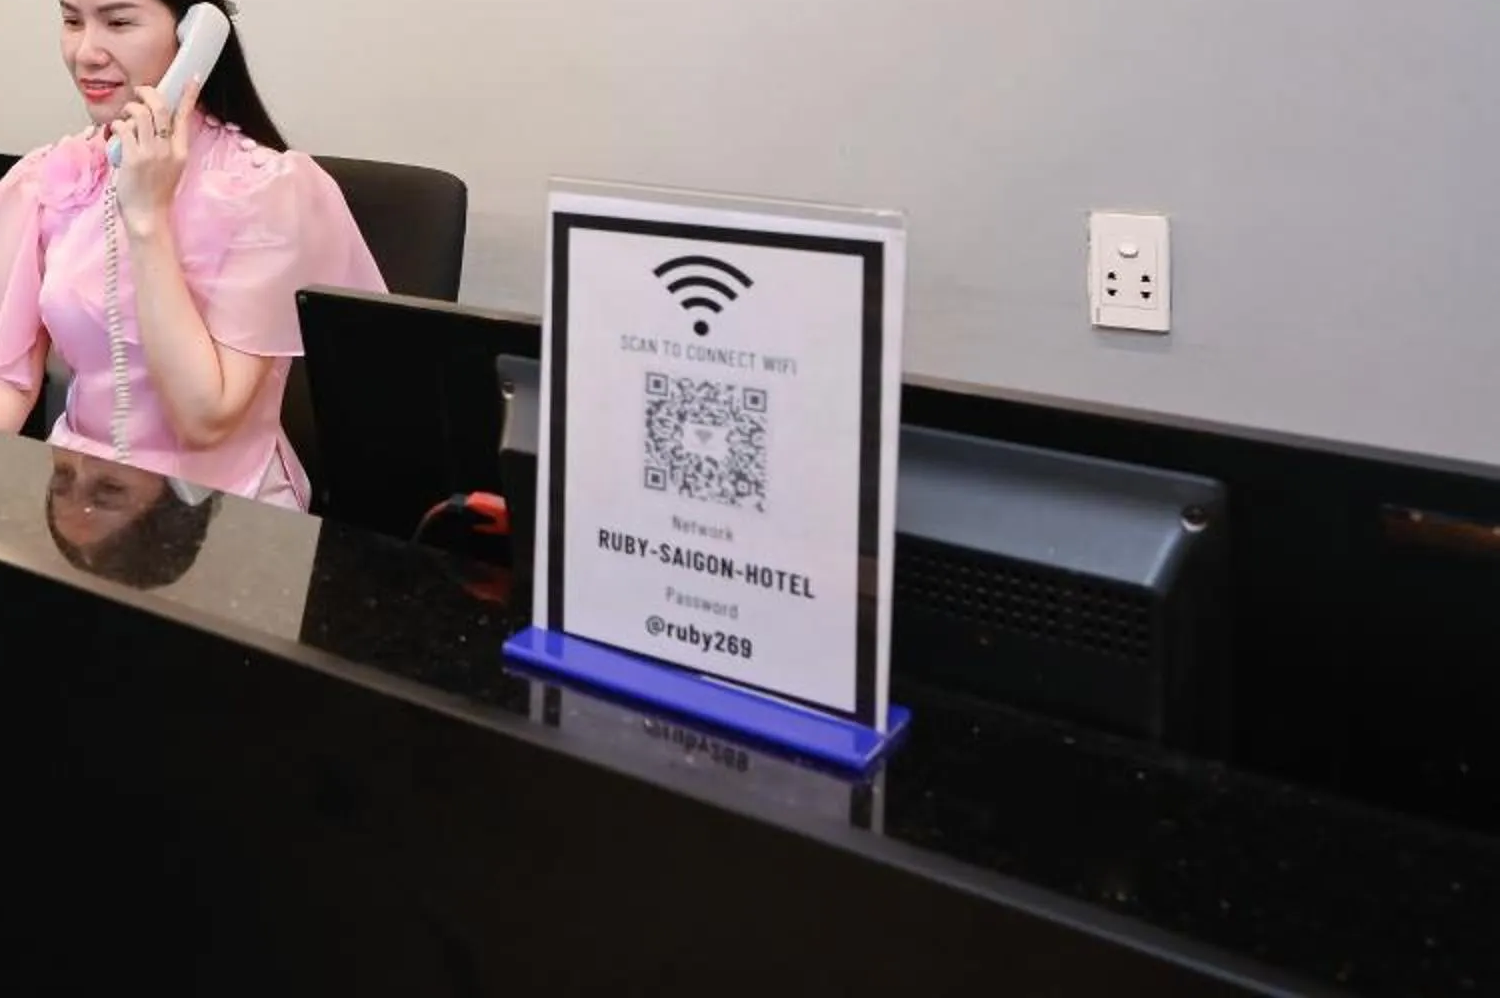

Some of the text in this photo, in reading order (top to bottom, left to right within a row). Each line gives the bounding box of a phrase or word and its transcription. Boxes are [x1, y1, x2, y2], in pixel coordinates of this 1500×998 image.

[620, 334, 798, 376] SCAN TO CONNECT WIFI
[671, 514, 734, 542] Network
[598, 527, 817, 600] RUBY-SAIGON-HOTEL
[663, 585, 740, 621] Password
[645, 614, 754, 660] @ruby269
